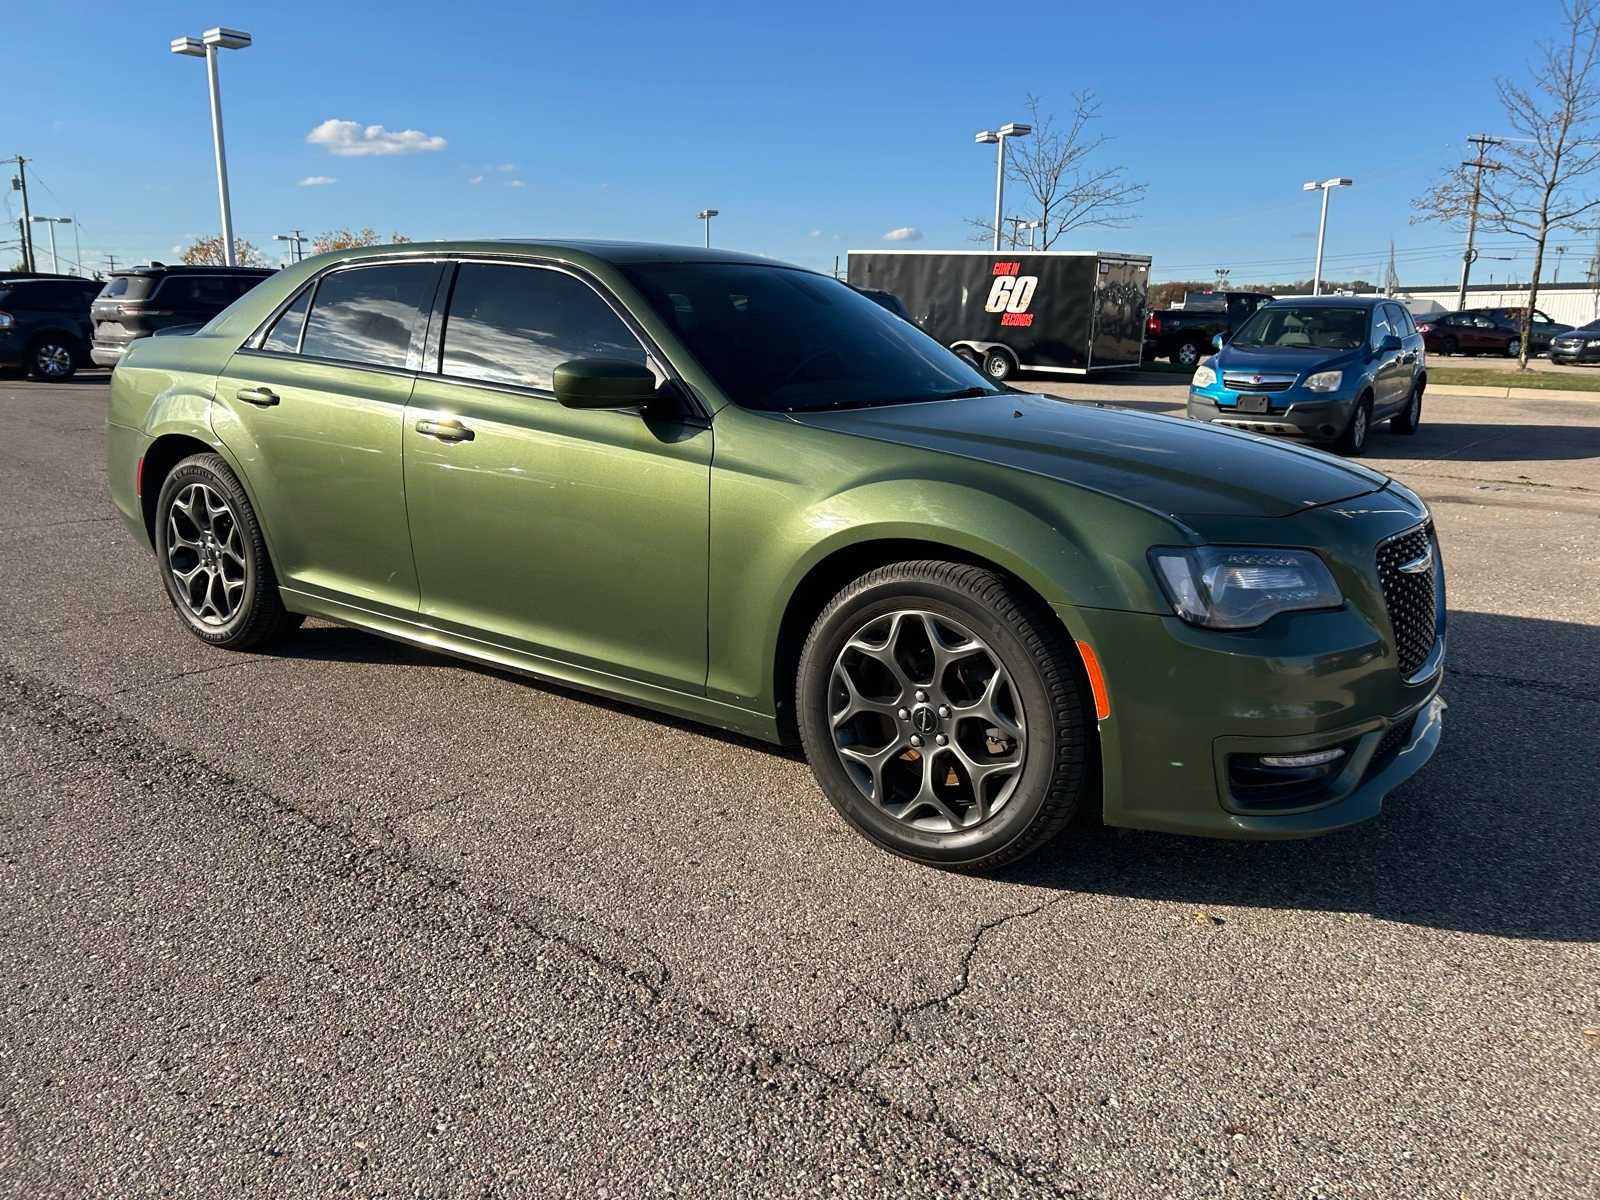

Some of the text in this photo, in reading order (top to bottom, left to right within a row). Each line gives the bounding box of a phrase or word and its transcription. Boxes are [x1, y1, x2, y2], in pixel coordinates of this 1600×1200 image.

[993, 262, 1020, 275] GONE IN
[985, 275, 1038, 313] 60
[1001, 313, 1034, 327] SECONDS
